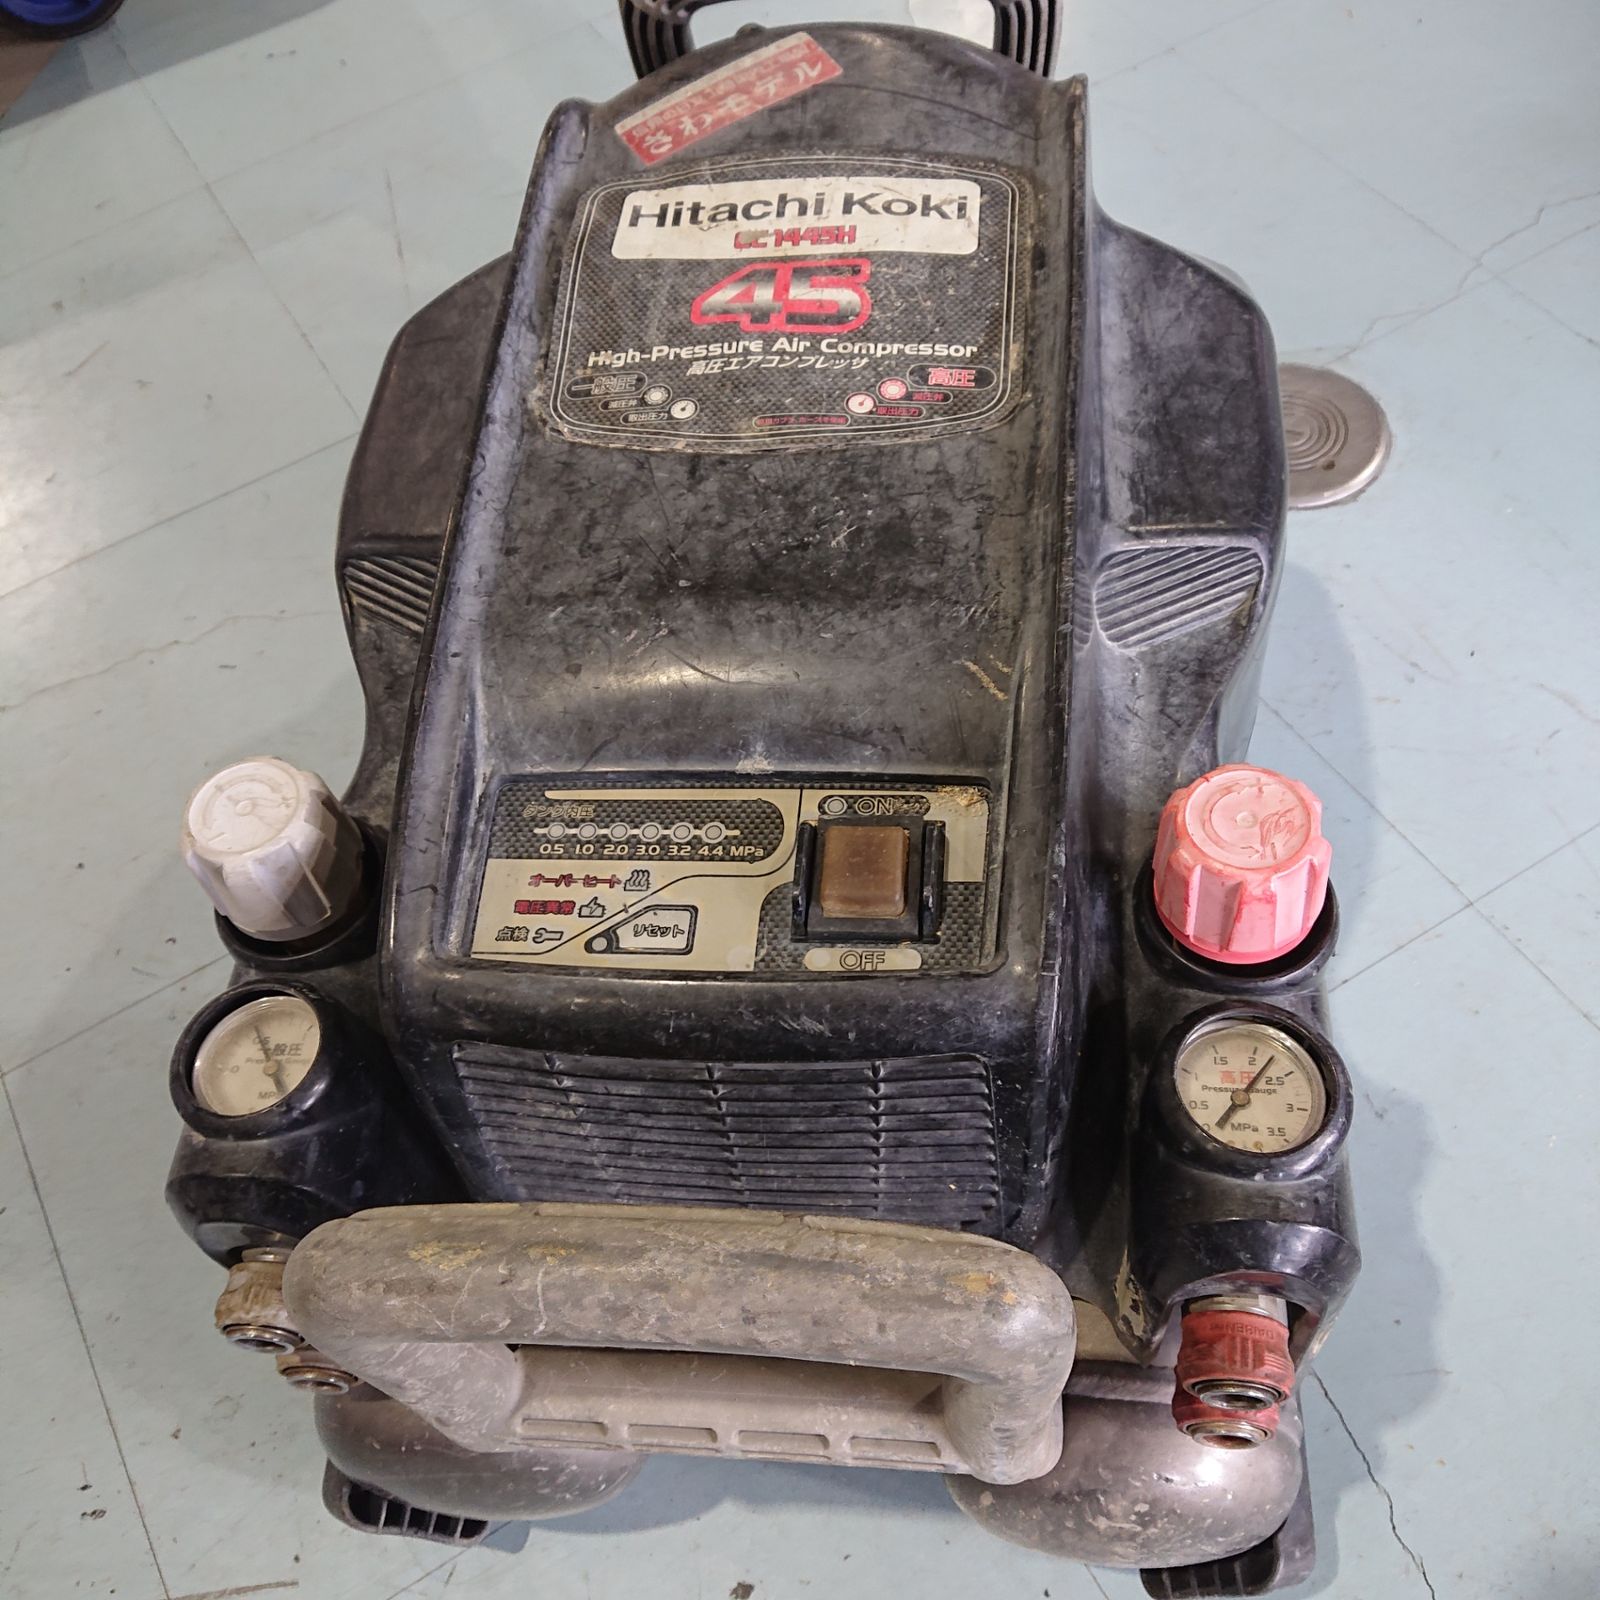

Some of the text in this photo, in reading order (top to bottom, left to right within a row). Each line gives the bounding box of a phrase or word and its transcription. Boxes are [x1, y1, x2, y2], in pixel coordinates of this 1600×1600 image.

[628, 187, 968, 230] Hitachi Koki
[690, 257, 872, 333] 45
[587, 336, 978, 368] High-Pressure Air Compressor
[686, 356, 870, 377] 高圧エアコンプレッサ
[571, 374, 638, 395] 一般圧
[928, 367, 976, 387] 高圧
[628, 412, 668, 422] 取出圧力
[523, 802, 596, 818] タンク内圧
[856, 796, 893, 816] ON
[540, 843, 764, 857] 0.5 1.0 2.0 3.0 3.2 4.4 MPa
[529, 873, 622, 888] オーバーヒート
[514, 900, 576, 915] 電圧異常
[495, 926, 530, 942] 点検
[633, 924, 685, 939] リセット
[840, 950, 886, 970] OFF
[1213, 1056, 1228, 1065] 1.5
[1248, 1056, 1257, 1066] 2
[1265, 1076, 1285, 1086] 2.5
[1202, 1085, 1240, 1093] Pressu
[1189, 1101, 1209, 1110] 0.5
[1286, 1103, 1294, 1113] 3
[1231, 1123, 1259, 1133] MPa
[1267, 1127, 1286, 1137] 3.5
